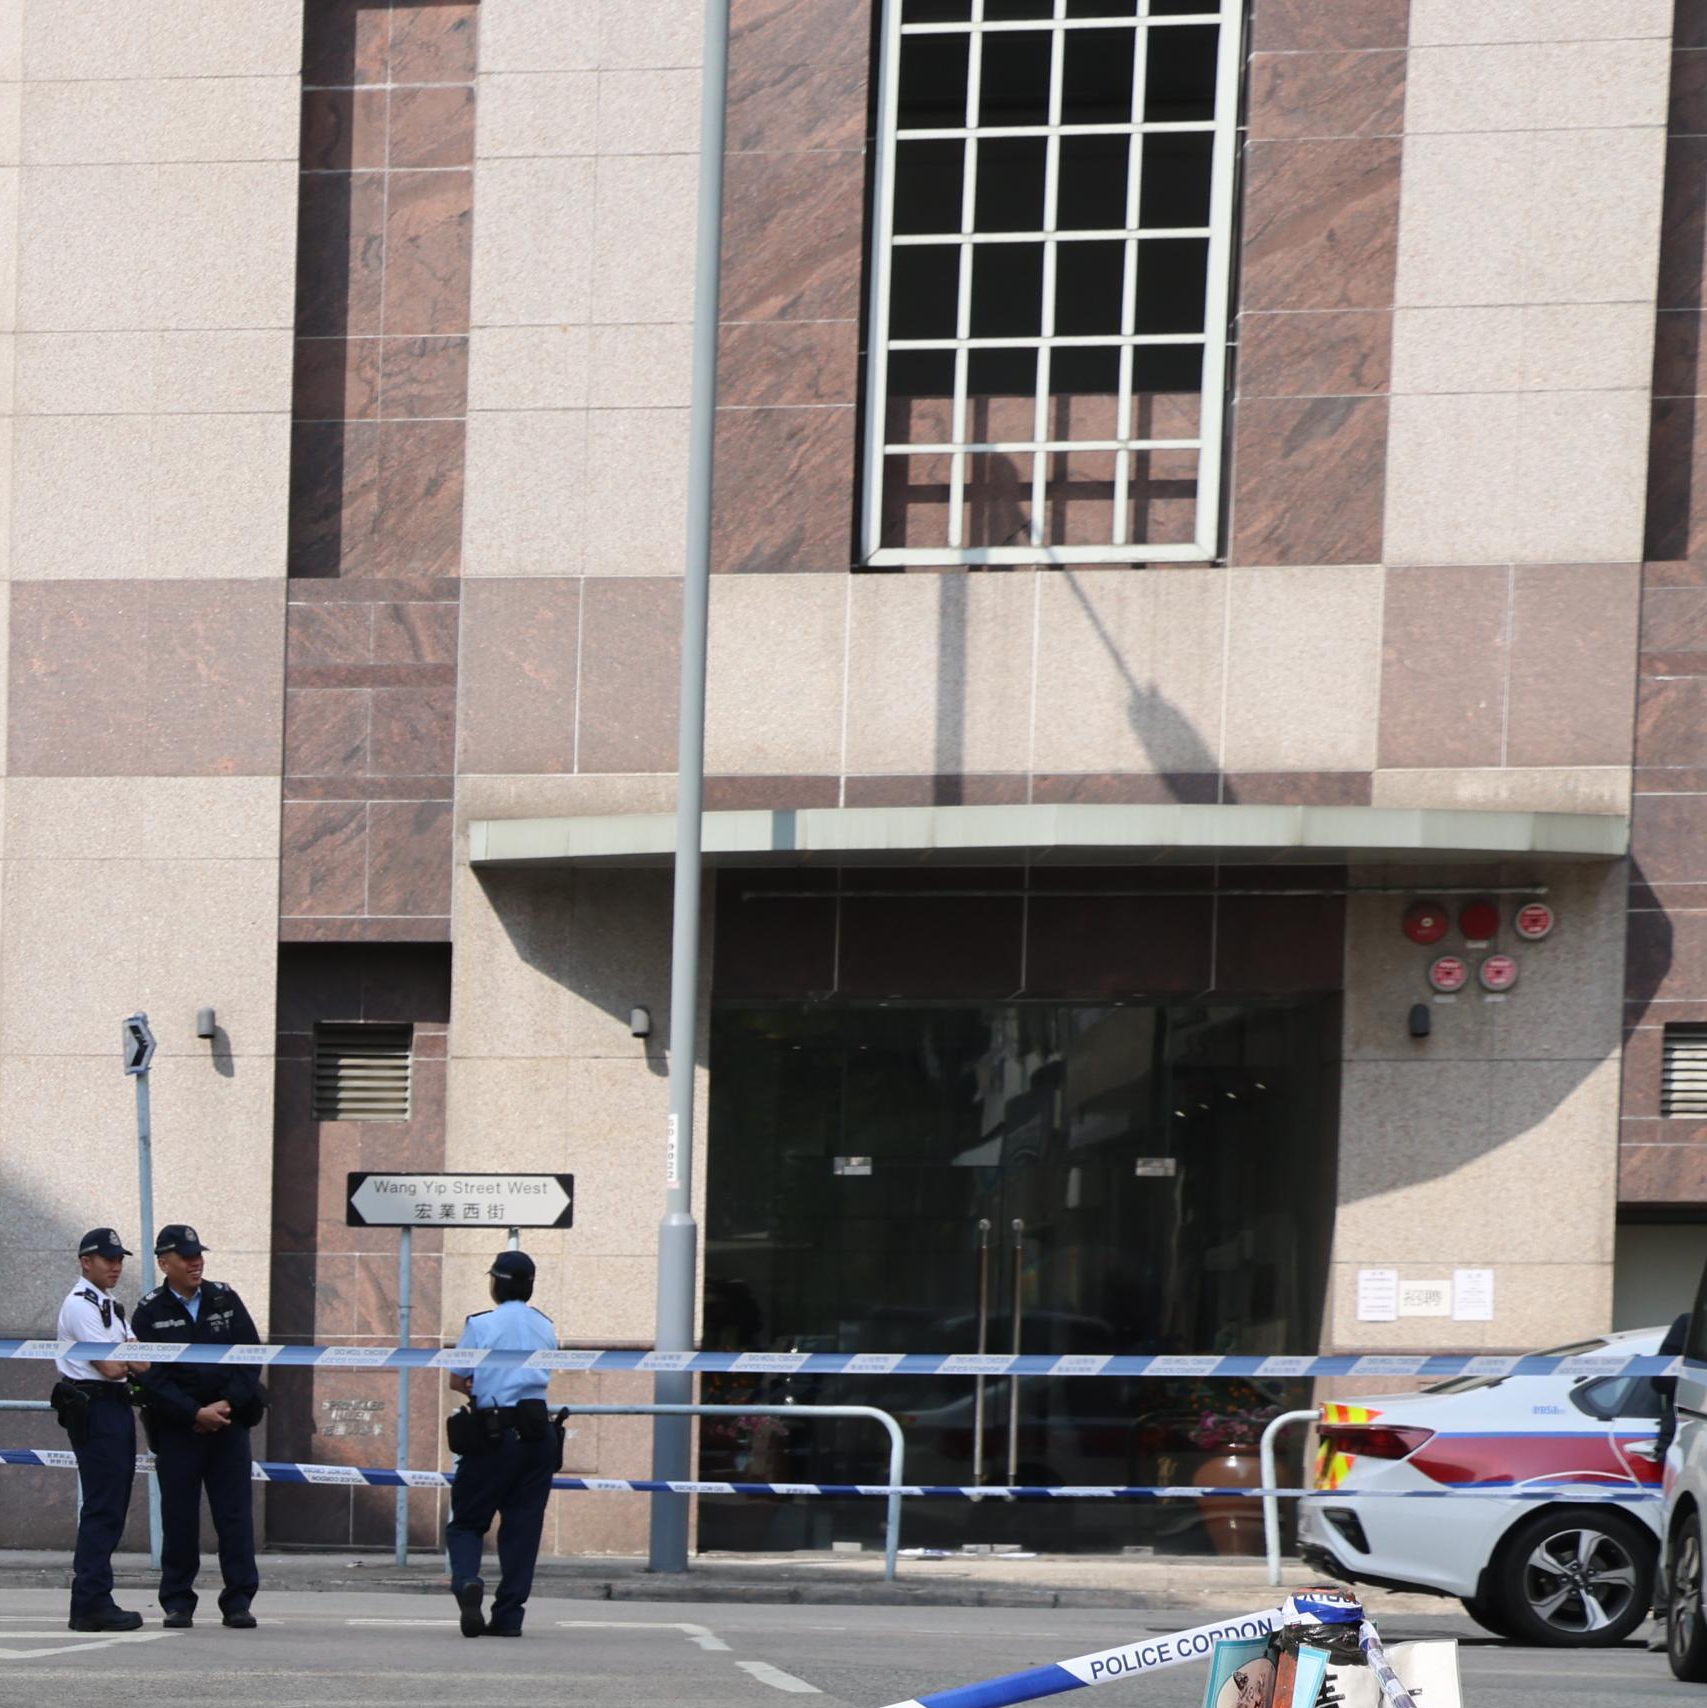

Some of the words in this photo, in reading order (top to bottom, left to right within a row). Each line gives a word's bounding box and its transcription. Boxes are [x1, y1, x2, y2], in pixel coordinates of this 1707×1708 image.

[374, 1180, 417, 1196] Wang
[423, 1180, 447, 1196] Yip
[452, 1181, 501, 1195] Street
[508, 1182, 547, 1195] West
[414, 1202, 505, 1220] 宏業西街
[1090, 1643, 1173, 1680] POLICE
